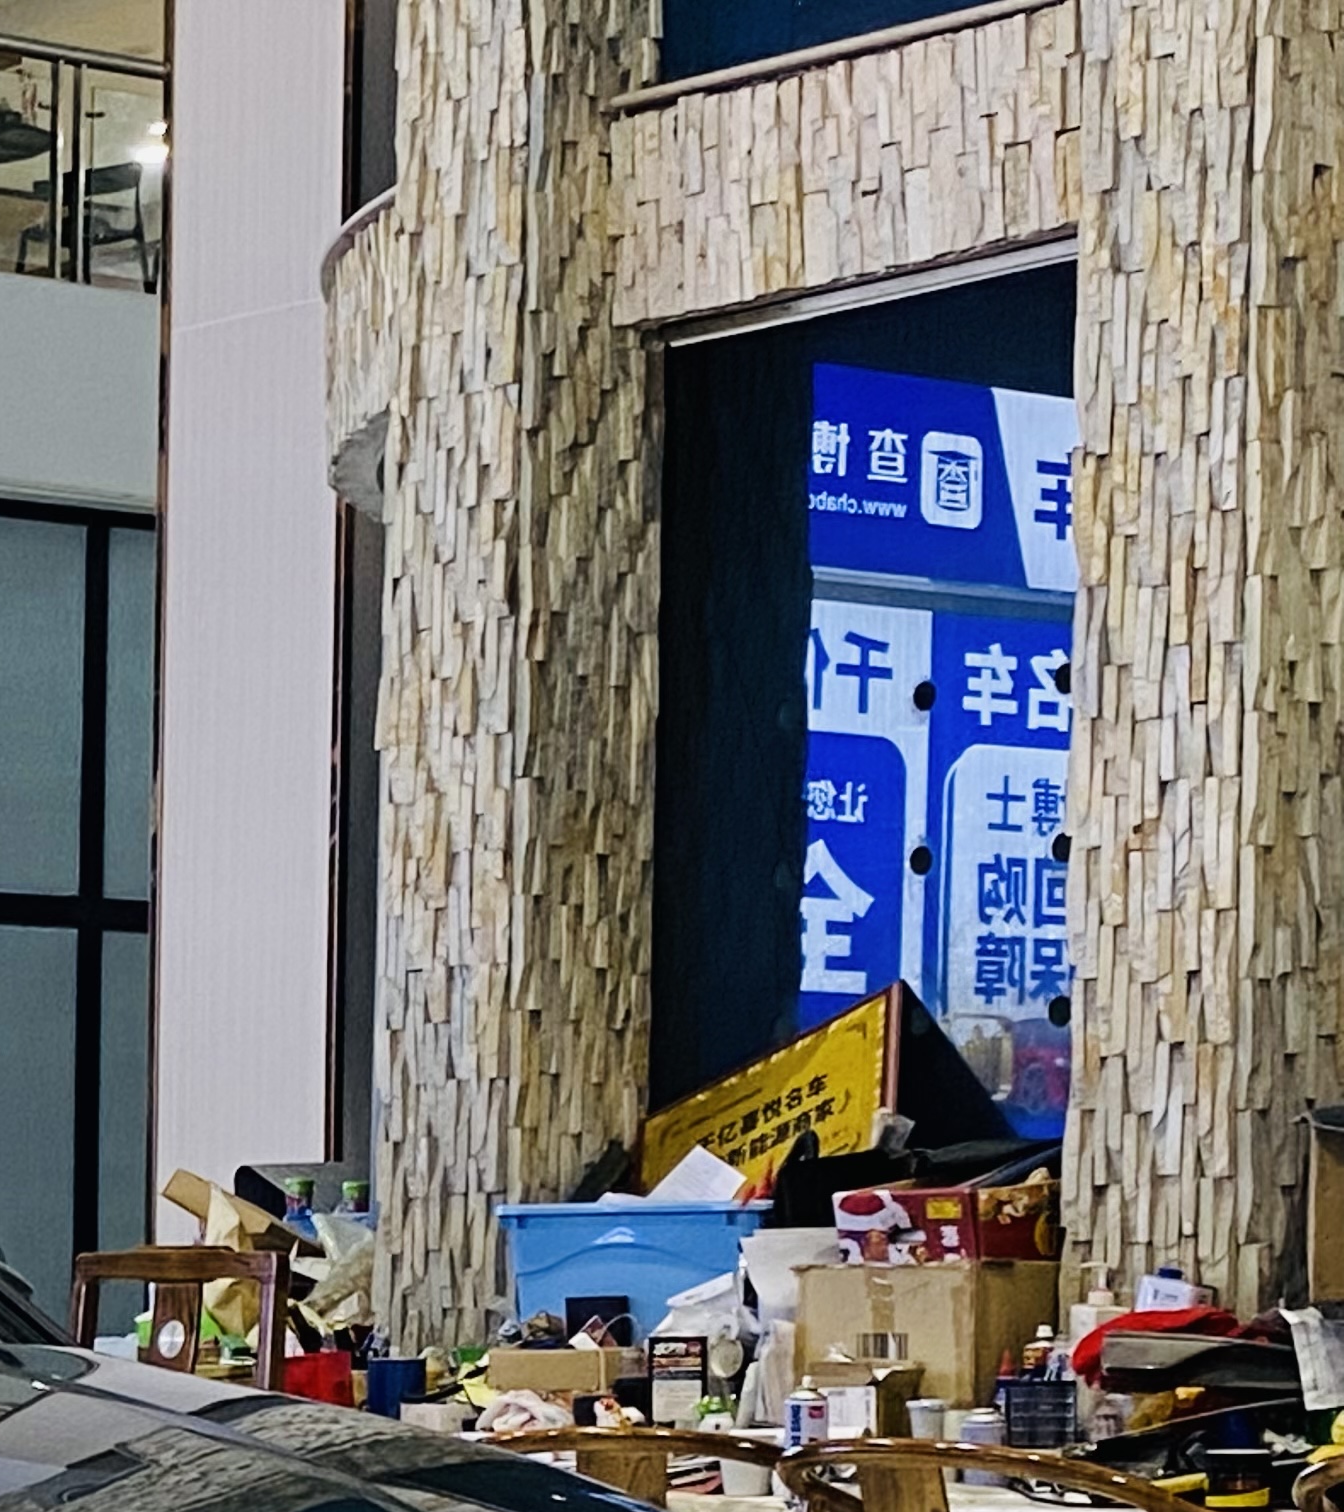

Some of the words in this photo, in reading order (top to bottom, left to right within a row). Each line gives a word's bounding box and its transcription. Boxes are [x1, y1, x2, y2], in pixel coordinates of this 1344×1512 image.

[717, 1096, 836, 1169] 新能源商家
